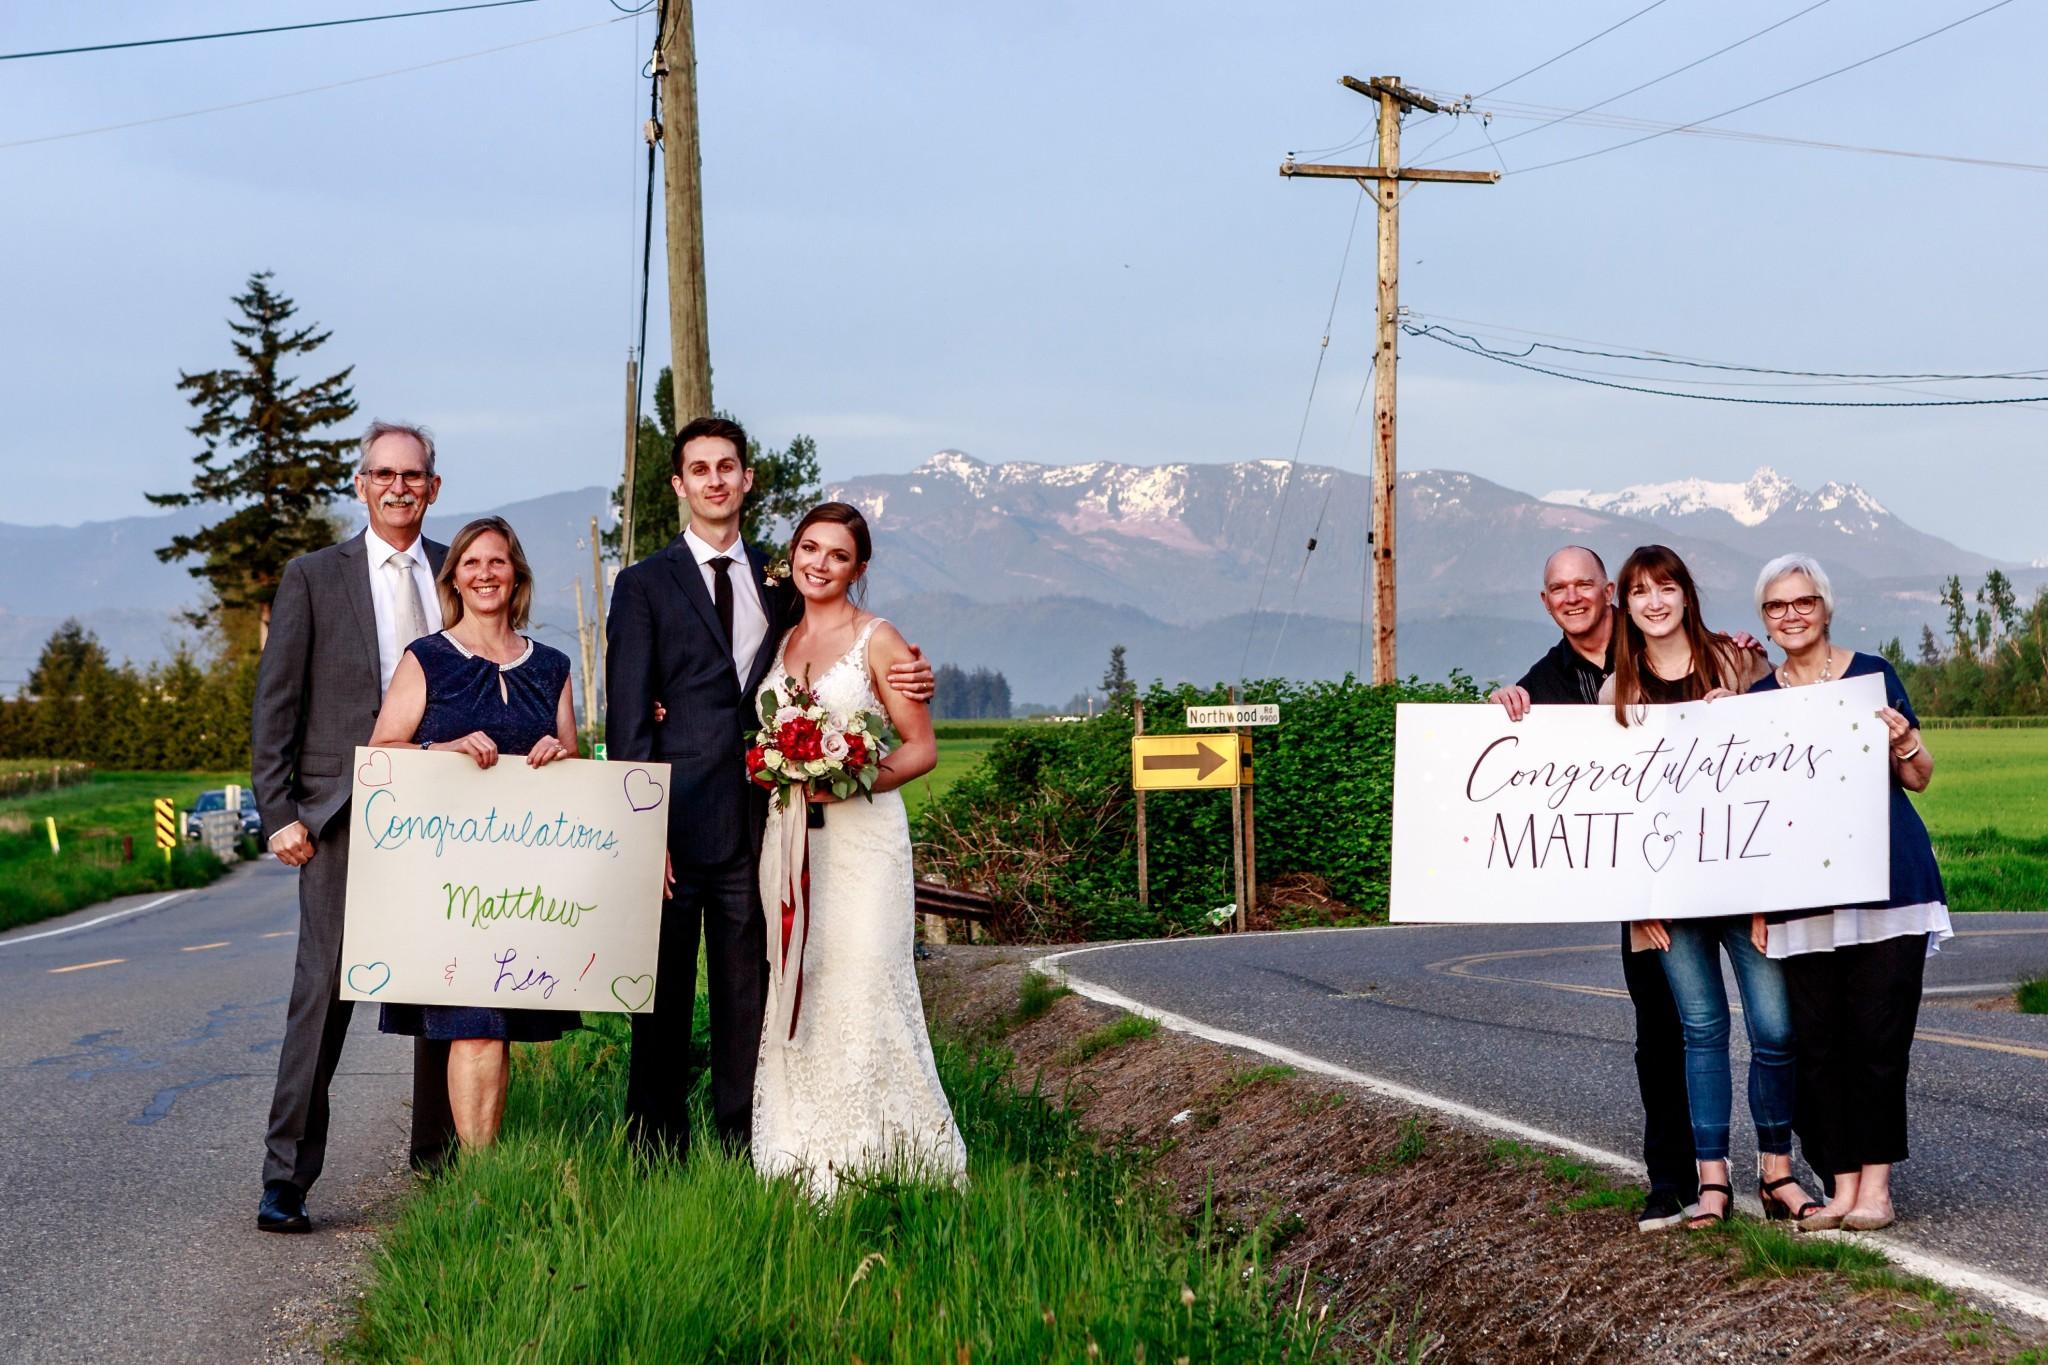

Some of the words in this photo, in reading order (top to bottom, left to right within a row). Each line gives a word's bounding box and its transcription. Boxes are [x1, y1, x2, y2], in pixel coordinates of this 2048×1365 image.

[1190, 708, 1257, 724] Northwood
[1259, 714, 1278, 723] 9900
[1263, 706, 1273, 714] Rd
[1465, 733, 1832, 809] Congratulations
[365, 789, 619, 858] Congratulations,
[1487, 812, 1634, 870] MATT
[1697, 800, 1772, 863] LIZ
[442, 882, 598, 930] Matthew
